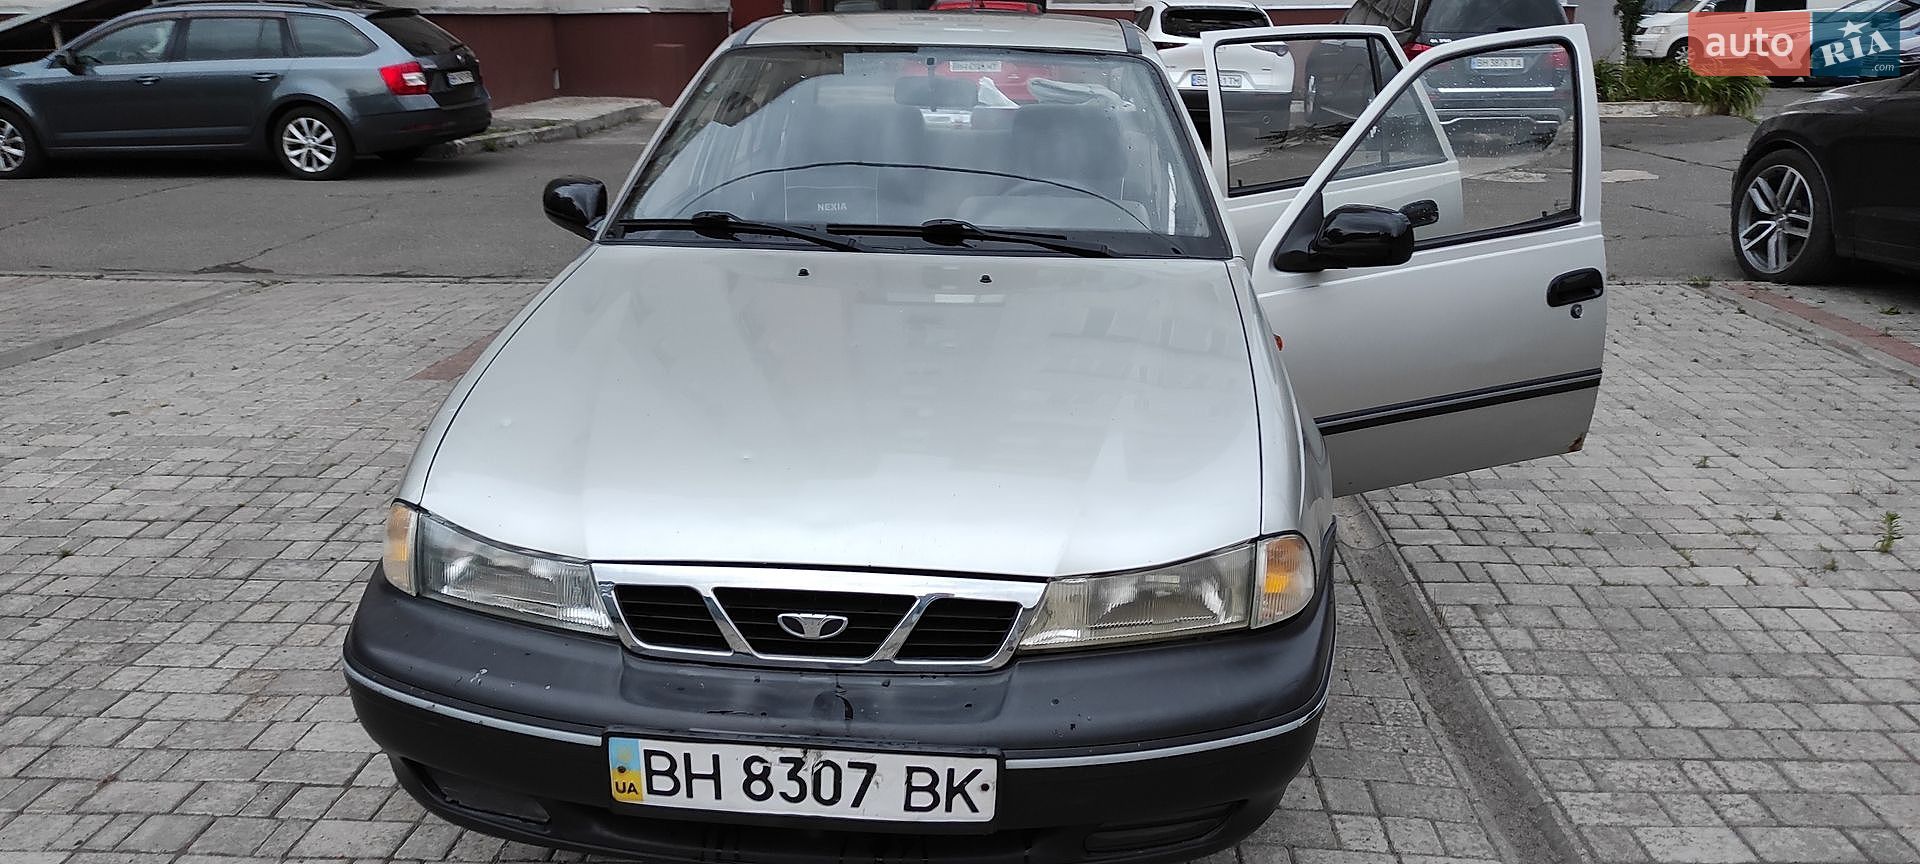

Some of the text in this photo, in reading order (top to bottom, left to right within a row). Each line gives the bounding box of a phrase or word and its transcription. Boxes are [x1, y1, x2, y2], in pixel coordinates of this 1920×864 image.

[817, 202, 848, 211] NEXIA
[615, 781, 639, 795] UA
[643, 749, 983, 814] BH 8307 BK
